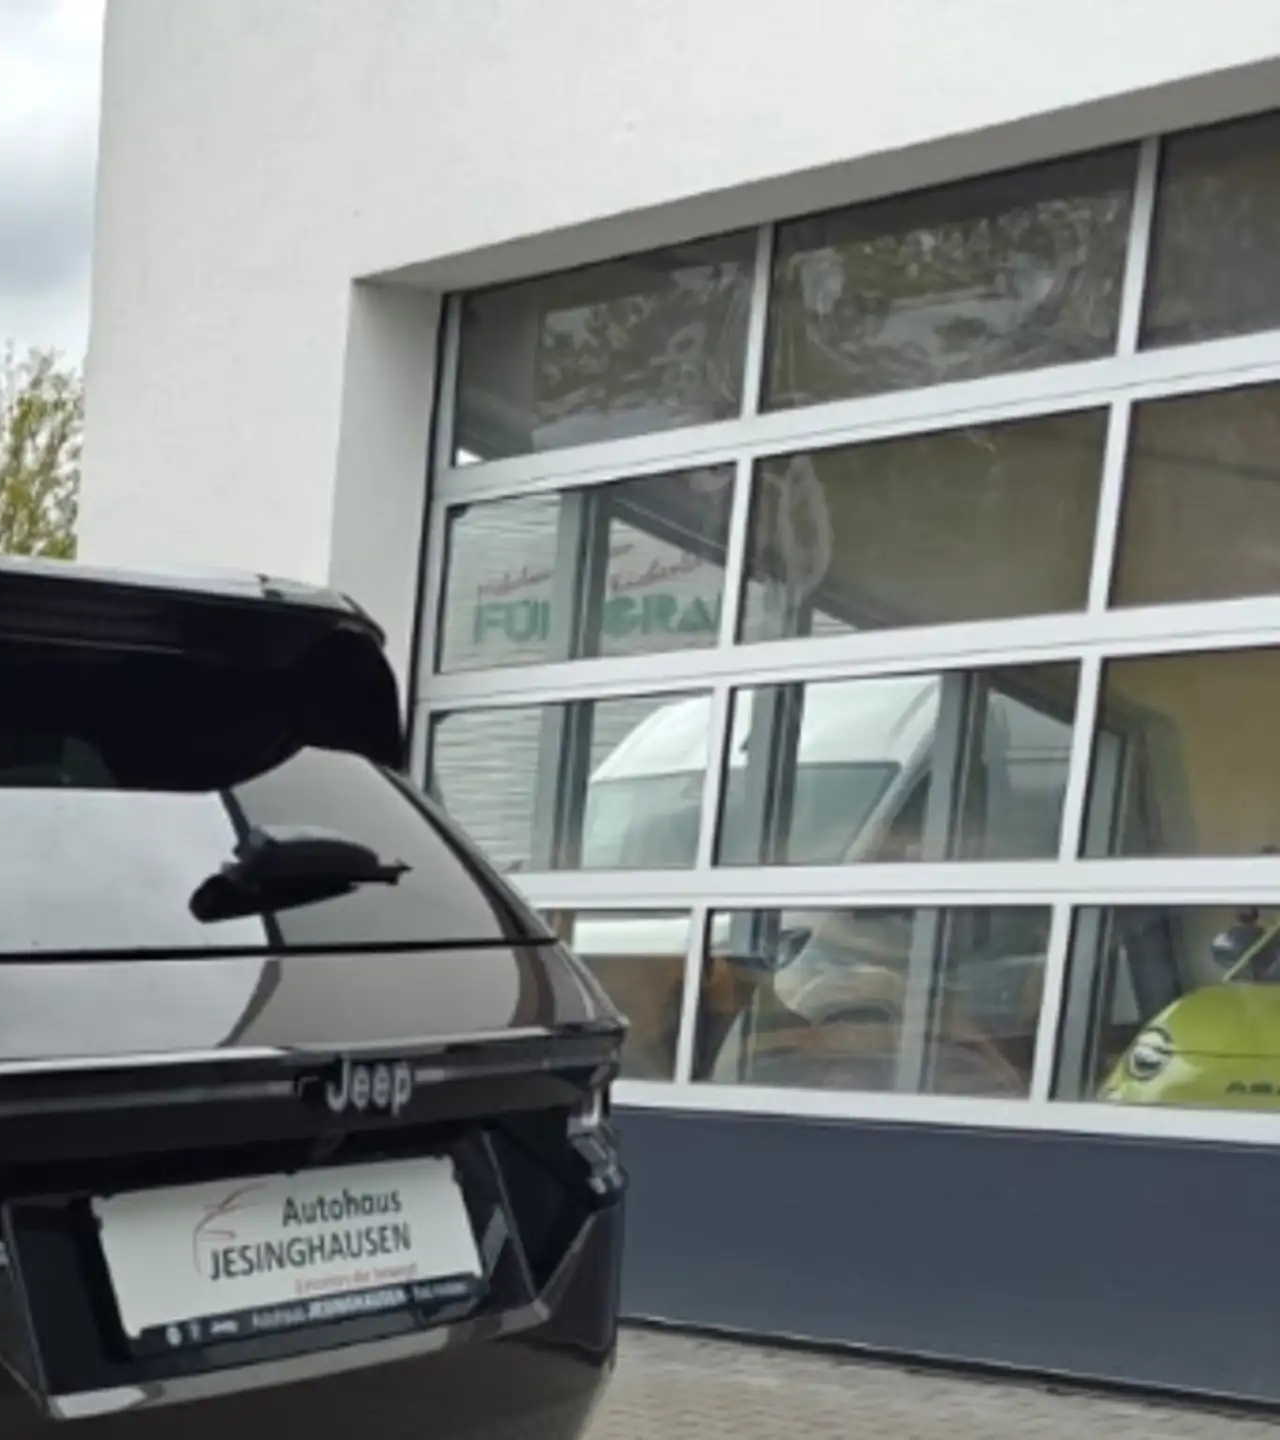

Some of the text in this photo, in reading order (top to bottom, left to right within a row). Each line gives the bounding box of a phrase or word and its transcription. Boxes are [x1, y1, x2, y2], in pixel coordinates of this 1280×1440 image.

[325, 1052, 412, 1117] Jeep
[282, 1188, 403, 1228] Autohaus
[209, 1221, 412, 1281] JESINGHAUSEN
